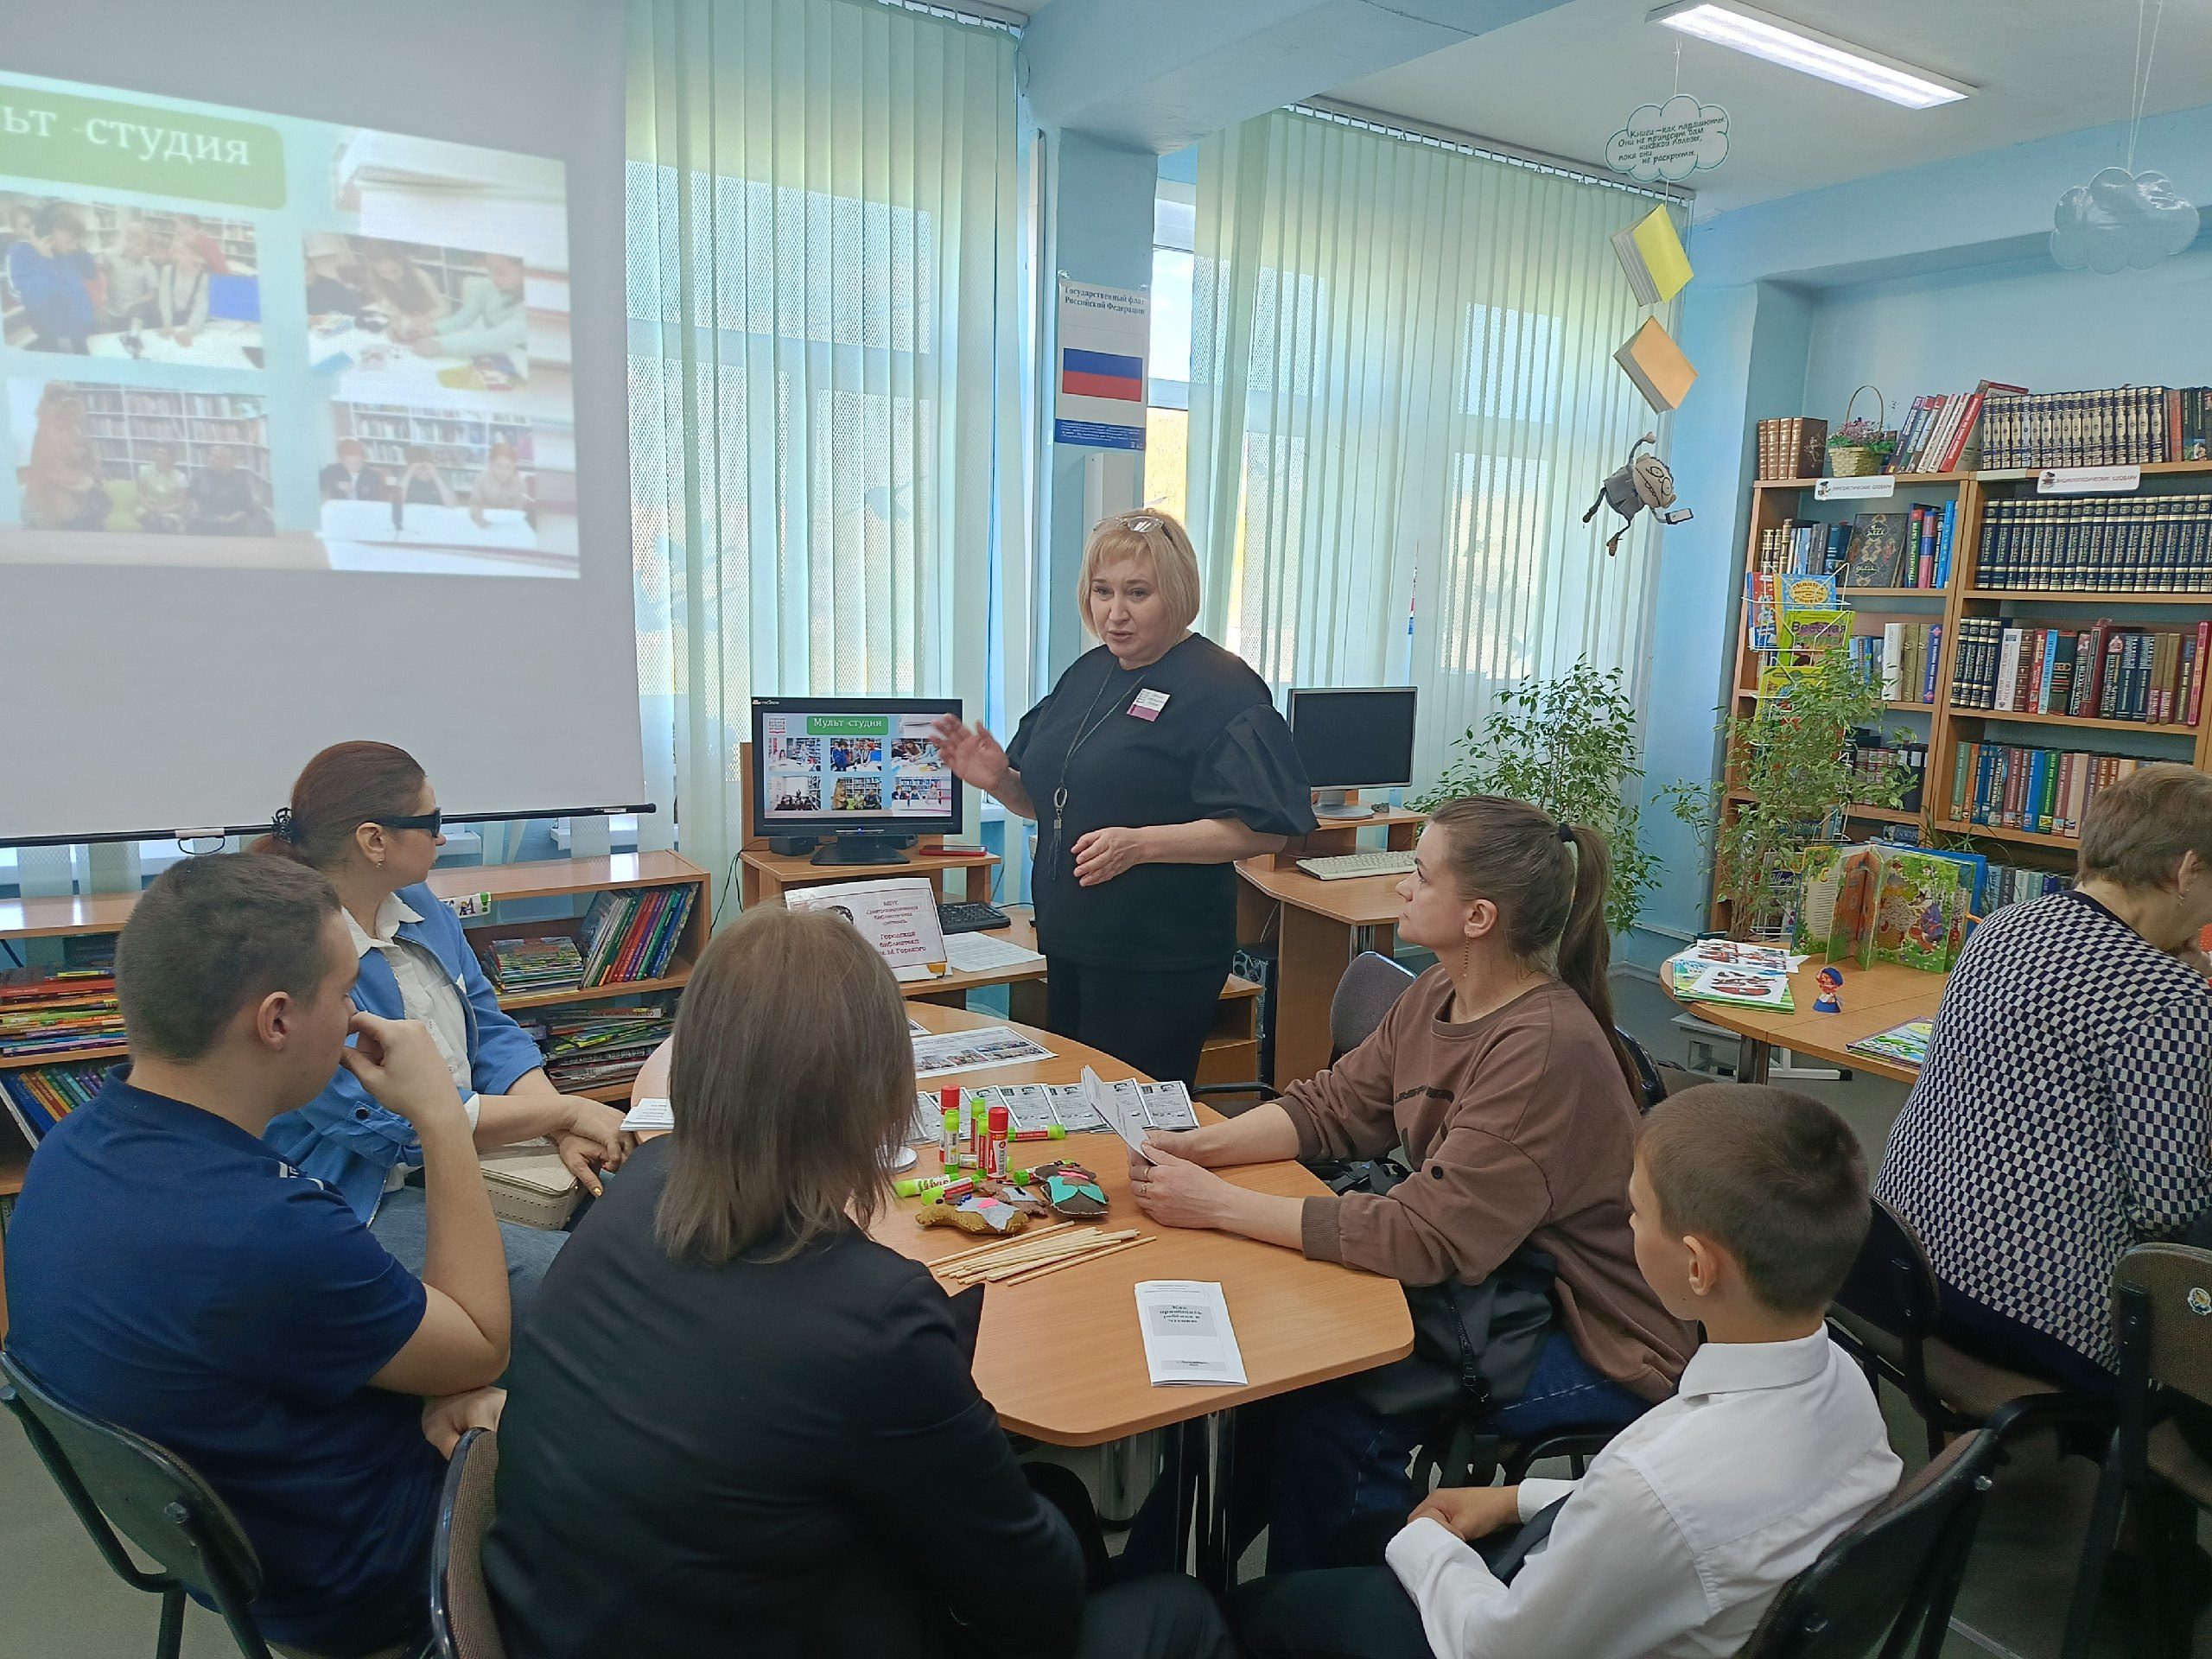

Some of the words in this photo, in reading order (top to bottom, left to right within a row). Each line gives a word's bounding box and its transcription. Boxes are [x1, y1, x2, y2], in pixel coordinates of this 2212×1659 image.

[1618, 139, 1634, 148] Они
[1065, 287, 1127, 302] Государственный
[1128, 296, 1145, 305] флаг
[1065, 296, 1106, 309] Российской
[1107, 302, 1145, 315] Федерации
[814, 718, 844, 728] Мульт
[880, 931, 916, 940] Городская
[880, 939, 919, 948] библиотека
